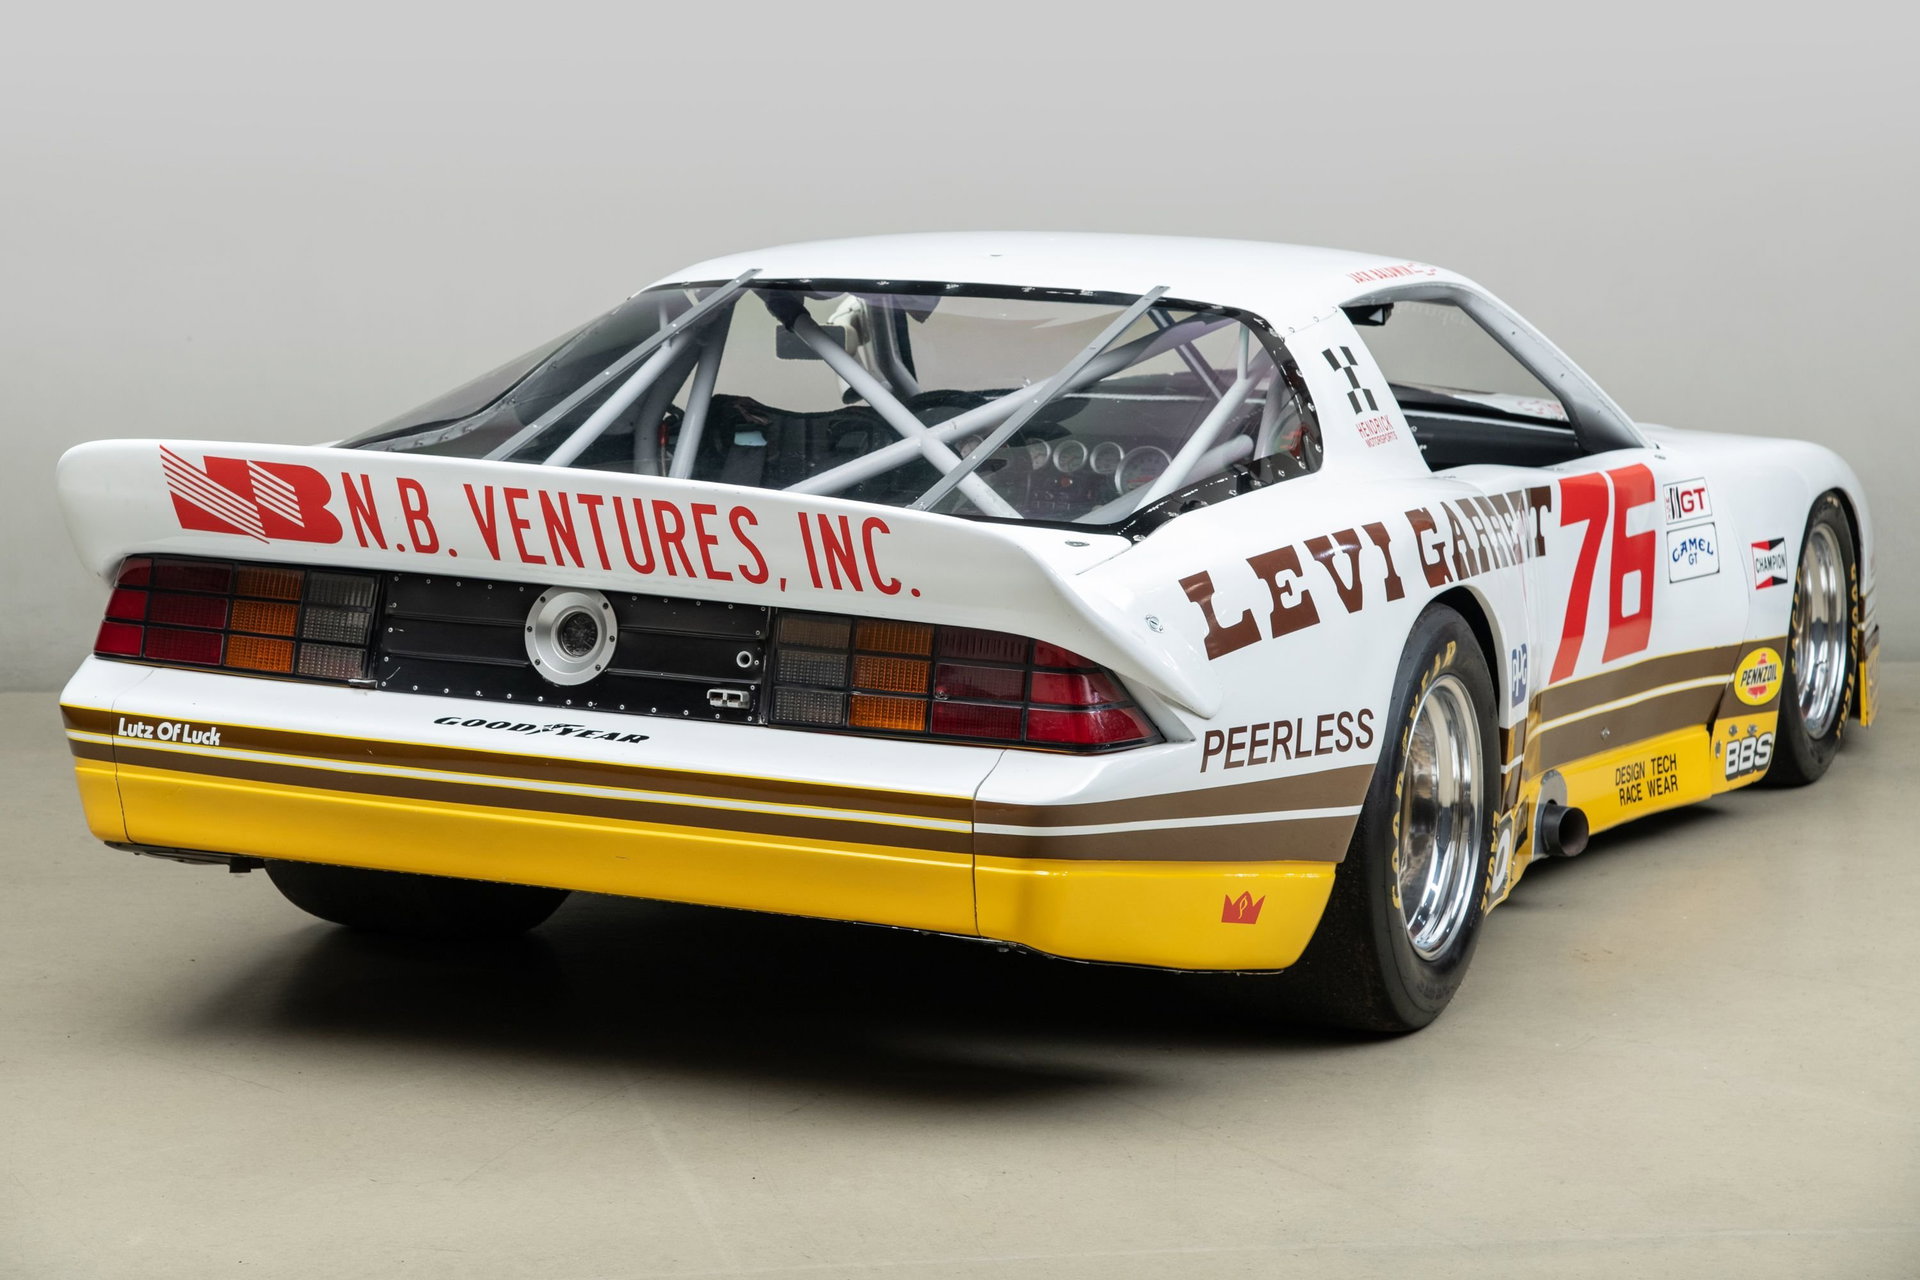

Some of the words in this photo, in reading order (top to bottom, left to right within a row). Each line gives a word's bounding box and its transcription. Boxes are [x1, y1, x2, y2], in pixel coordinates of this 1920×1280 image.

[1355, 415, 1394, 439] HENDRICK
[1680, 487, 1706, 513] GT
[341, 472, 458, 557] N.B.
[464, 483, 787, 592] VENTURES,
[798, 511, 922, 598] INC.
[1672, 537, 1714, 563] CAMEL
[1548, 462, 1656, 686] 76
[1688, 552, 1698, 566] GT
[1755, 553, 1786, 574] CHAMPION
[1178, 521, 1406, 660] LEVI
[1740, 664, 1778, 687] PENNZOIL
[118, 717, 155, 739] Lutz
[157, 721, 182, 742] Of
[182, 723, 221, 746] Luck
[1200, 708, 1375, 773] PEERLESS
[1615, 761, 1646, 786] DESIGN
[1650, 753, 1678, 776] TECH
[1725, 732, 1774, 780] BBS
[1619, 783, 1643, 807] RACE
[1647, 774, 1679, 798] WEAR
